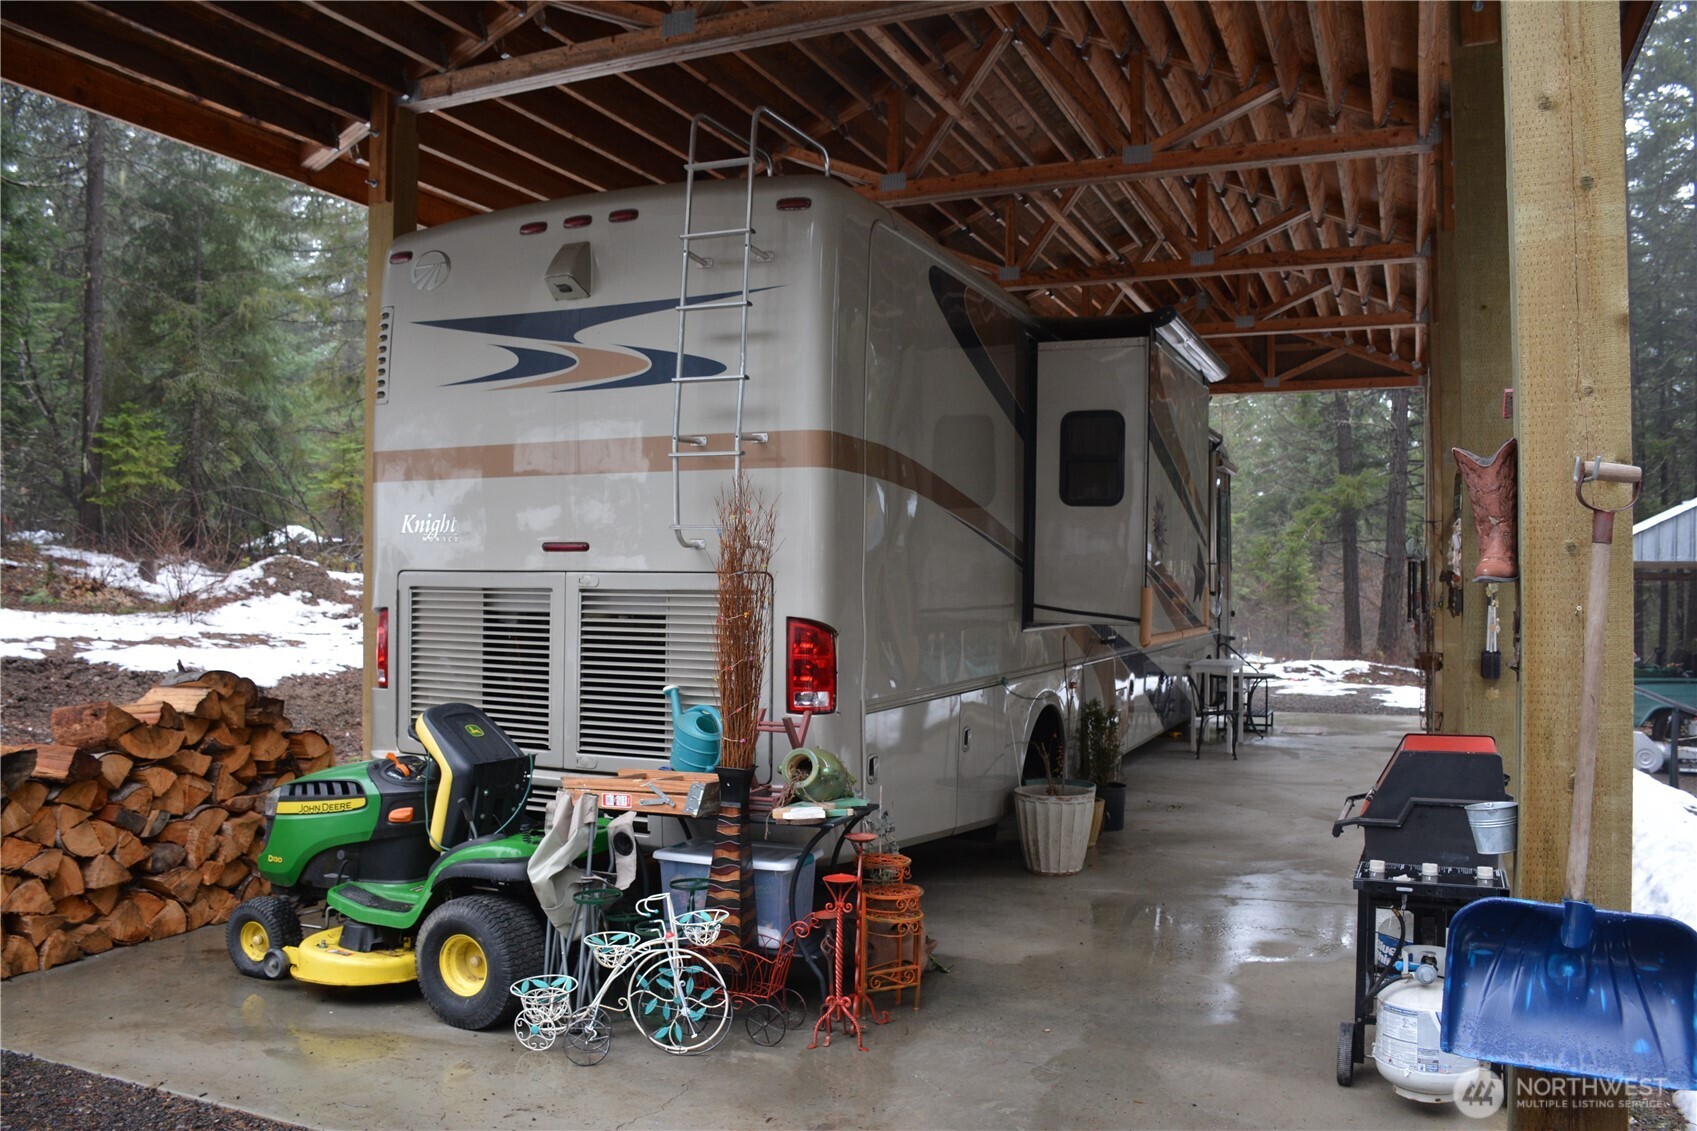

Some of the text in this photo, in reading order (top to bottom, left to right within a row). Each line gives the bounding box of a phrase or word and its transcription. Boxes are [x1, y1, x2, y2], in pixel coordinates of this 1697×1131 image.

[401, 513, 458, 540] Knight
[299, 801, 352, 813] JOHN DEERE
